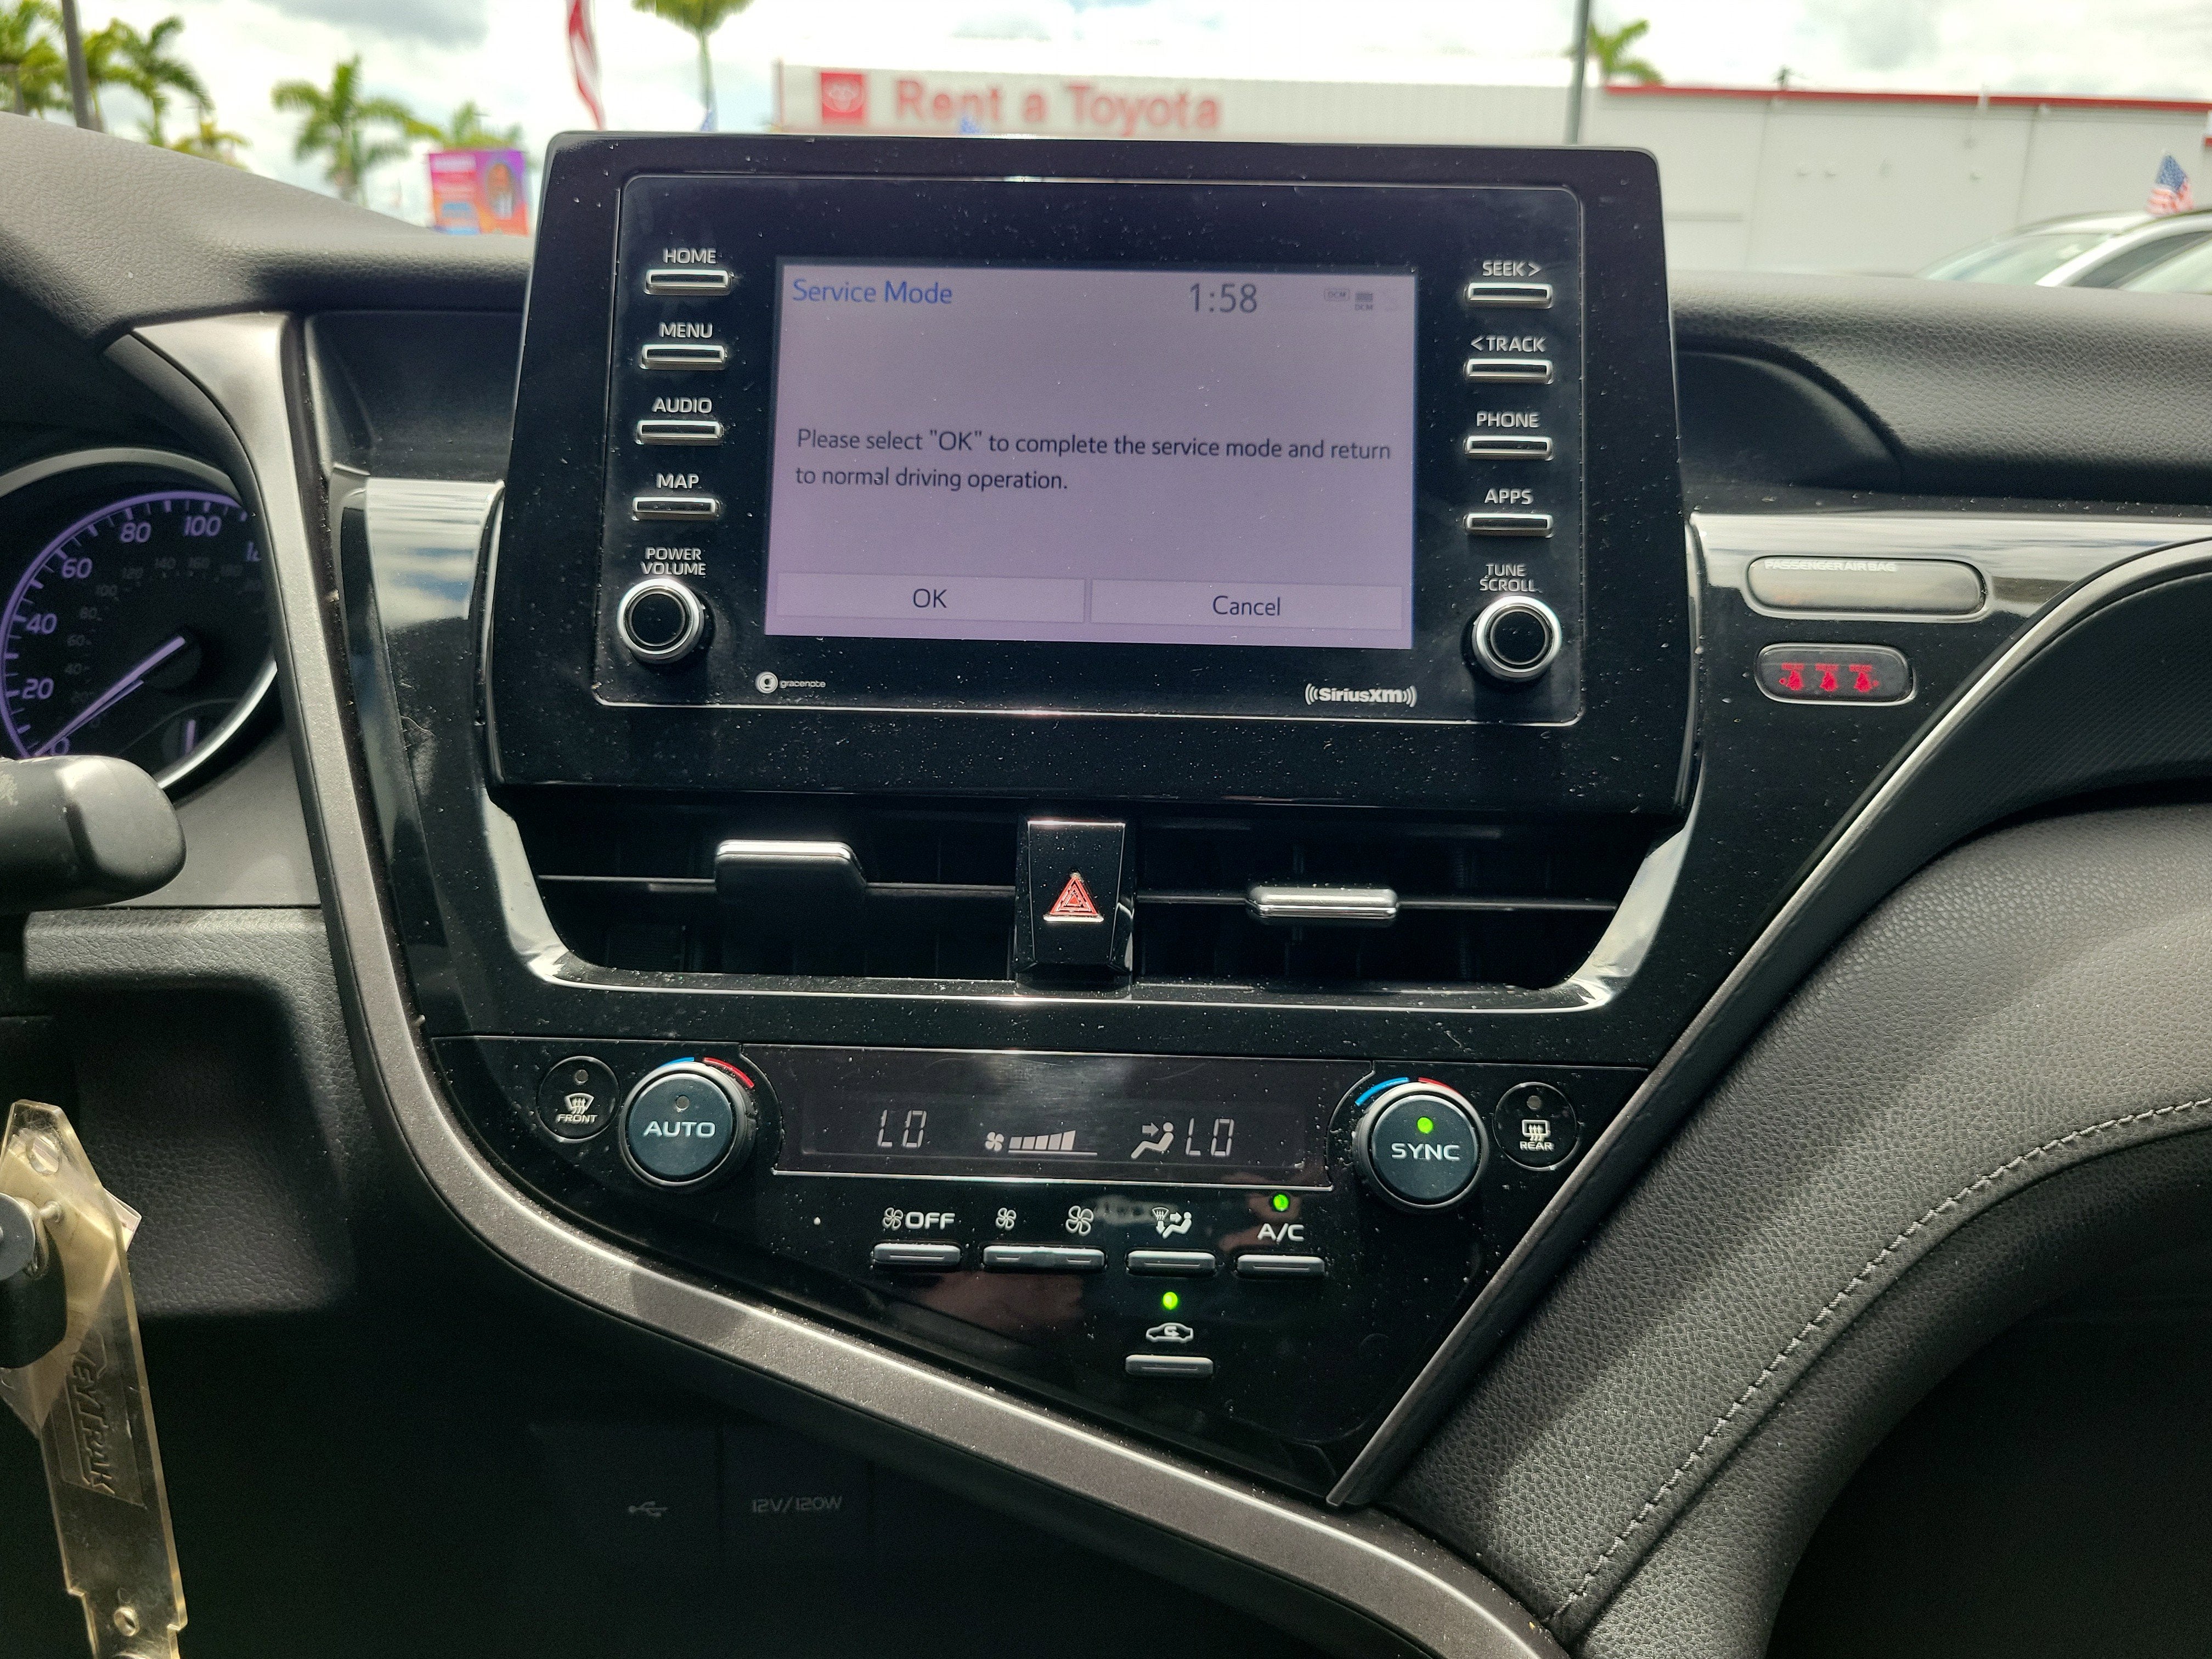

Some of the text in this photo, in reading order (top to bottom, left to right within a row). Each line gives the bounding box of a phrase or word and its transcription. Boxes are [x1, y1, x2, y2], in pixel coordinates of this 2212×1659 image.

[895, 79, 1222, 137] Rent a Toyota
[663, 249, 716, 264] HOME
[793, 278, 952, 303] Service Mode
[1190, 283, 1257, 313] 1:58
[659, 323, 713, 338] MENU
[652, 397, 712, 414] AUDIO
[1476, 411, 1539, 428] PHONE
[798, 428, 1390, 460] Please select "OK" to complete the service mode and return
[656, 473, 699, 489] MAP
[796, 467, 1068, 492] to normal driving operation.
[1484, 489, 1533, 505] APPS
[120, 522, 151, 543] 80
[184, 516, 222, 537] 100
[645, 547, 702, 561] POWER
[61, 557, 93, 578] 60
[640, 561, 707, 576] VOLUME
[1486, 564, 1527, 577] TUNE
[1764, 559, 1844, 571] PASSENGER
[1480, 578, 1536, 592] SCROLL
[912, 588, 947, 609] OK
[1212, 595, 1280, 616] Cancel
[25, 613, 58, 635] 40
[22, 678, 54, 699] 20
[778, 680, 826, 689] gracenote
[556, 1113, 597, 1124] FRONT
[643, 1120, 716, 1138] AUTO
[1391, 1142, 1461, 1161] SYNC
[1520, 1141, 1554, 1152] REAR
[905, 1211, 956, 1229] OFF
[1257, 1222, 1305, 1242] A/C
[752, 1496, 843, 1514] 12V/120W
